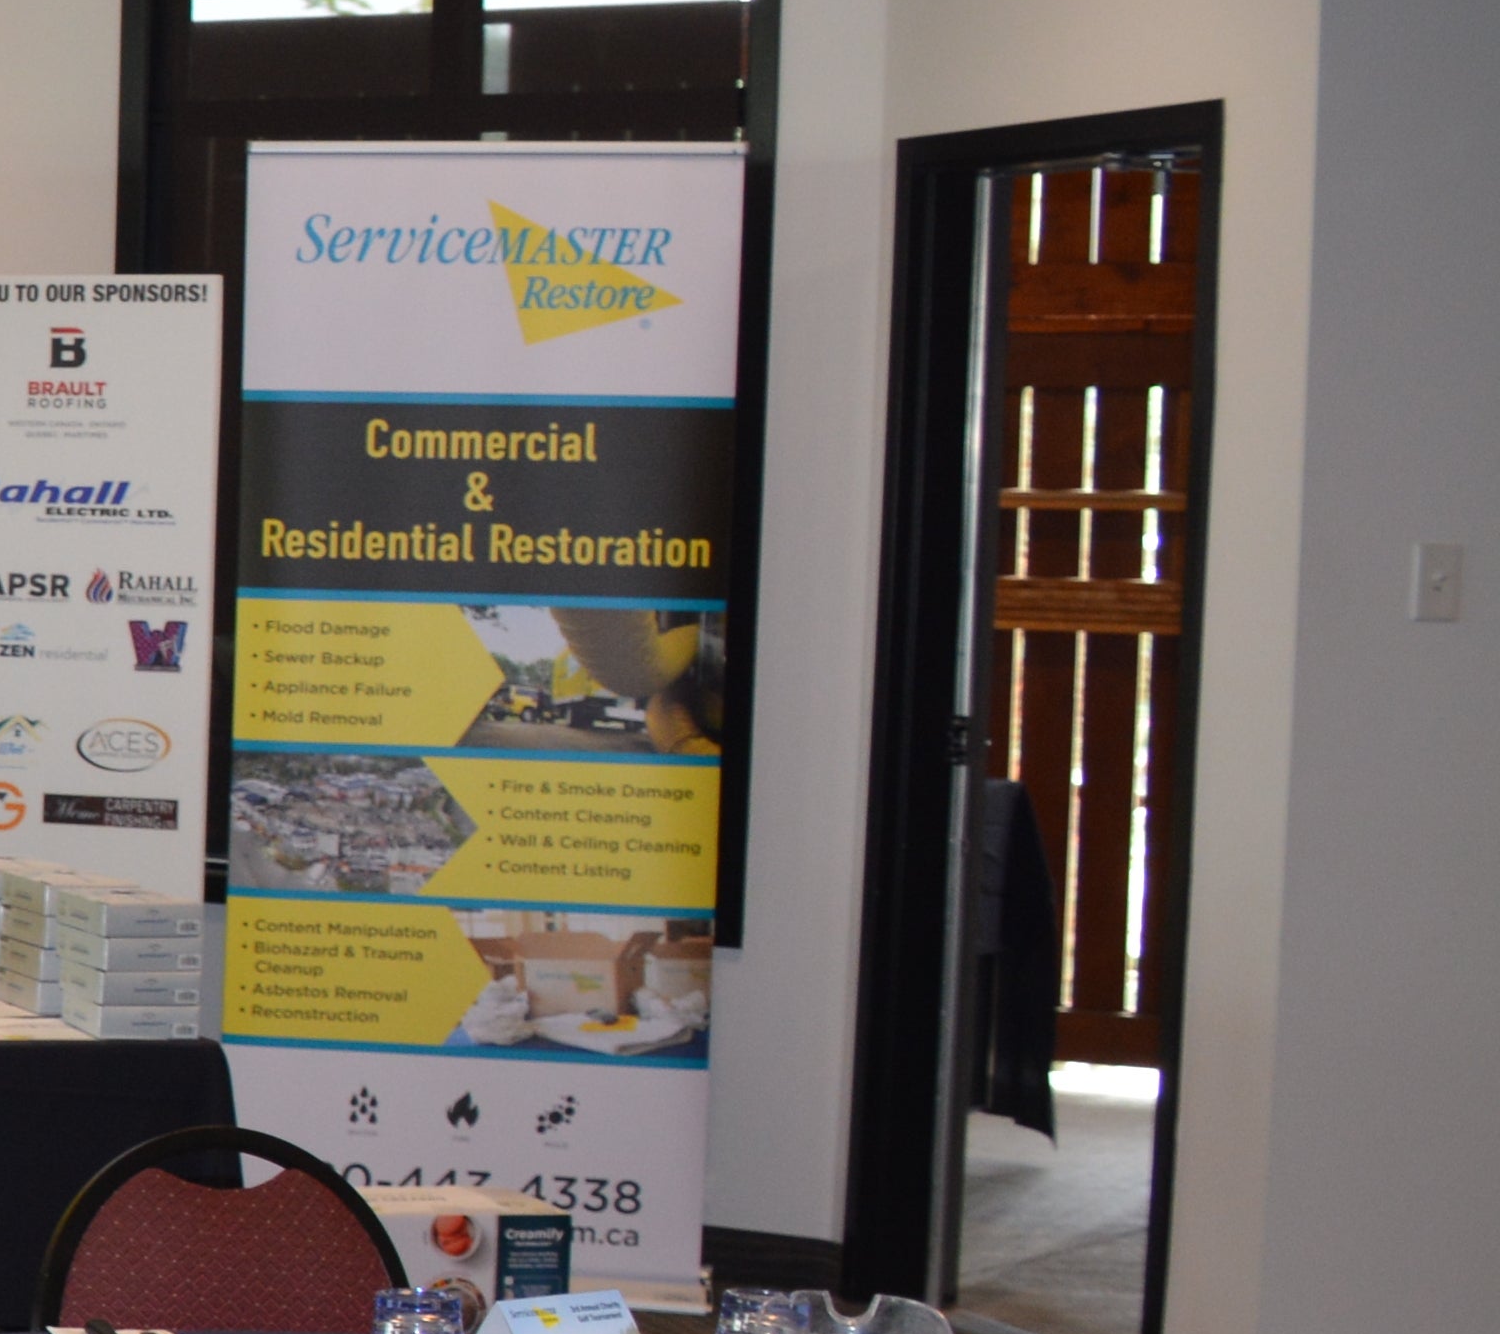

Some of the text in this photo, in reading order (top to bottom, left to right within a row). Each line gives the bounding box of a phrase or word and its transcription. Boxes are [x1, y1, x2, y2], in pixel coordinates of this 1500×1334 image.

[297, 213, 672, 266] ServiceMASTER
[17, 284, 39, 302] TO
[46, 284, 85, 302] OUR
[93, 284, 208, 303] SPONSORS!
[519, 275, 655, 310] Restore
[28, 382, 106, 396] BRAULT
[28, 398, 106, 409] ROOFING
[366, 418, 597, 461] Commercial
[464, 471, 494, 511] &
[262, 519, 711, 568] Residential Restoration
[265, 620, 390, 639] Flood Damage
[0, 645, 35, 658] ZEN
[264, 650, 384, 668] Sewer Backup
[502, 780, 693, 802] Fire & Smoke Damage
